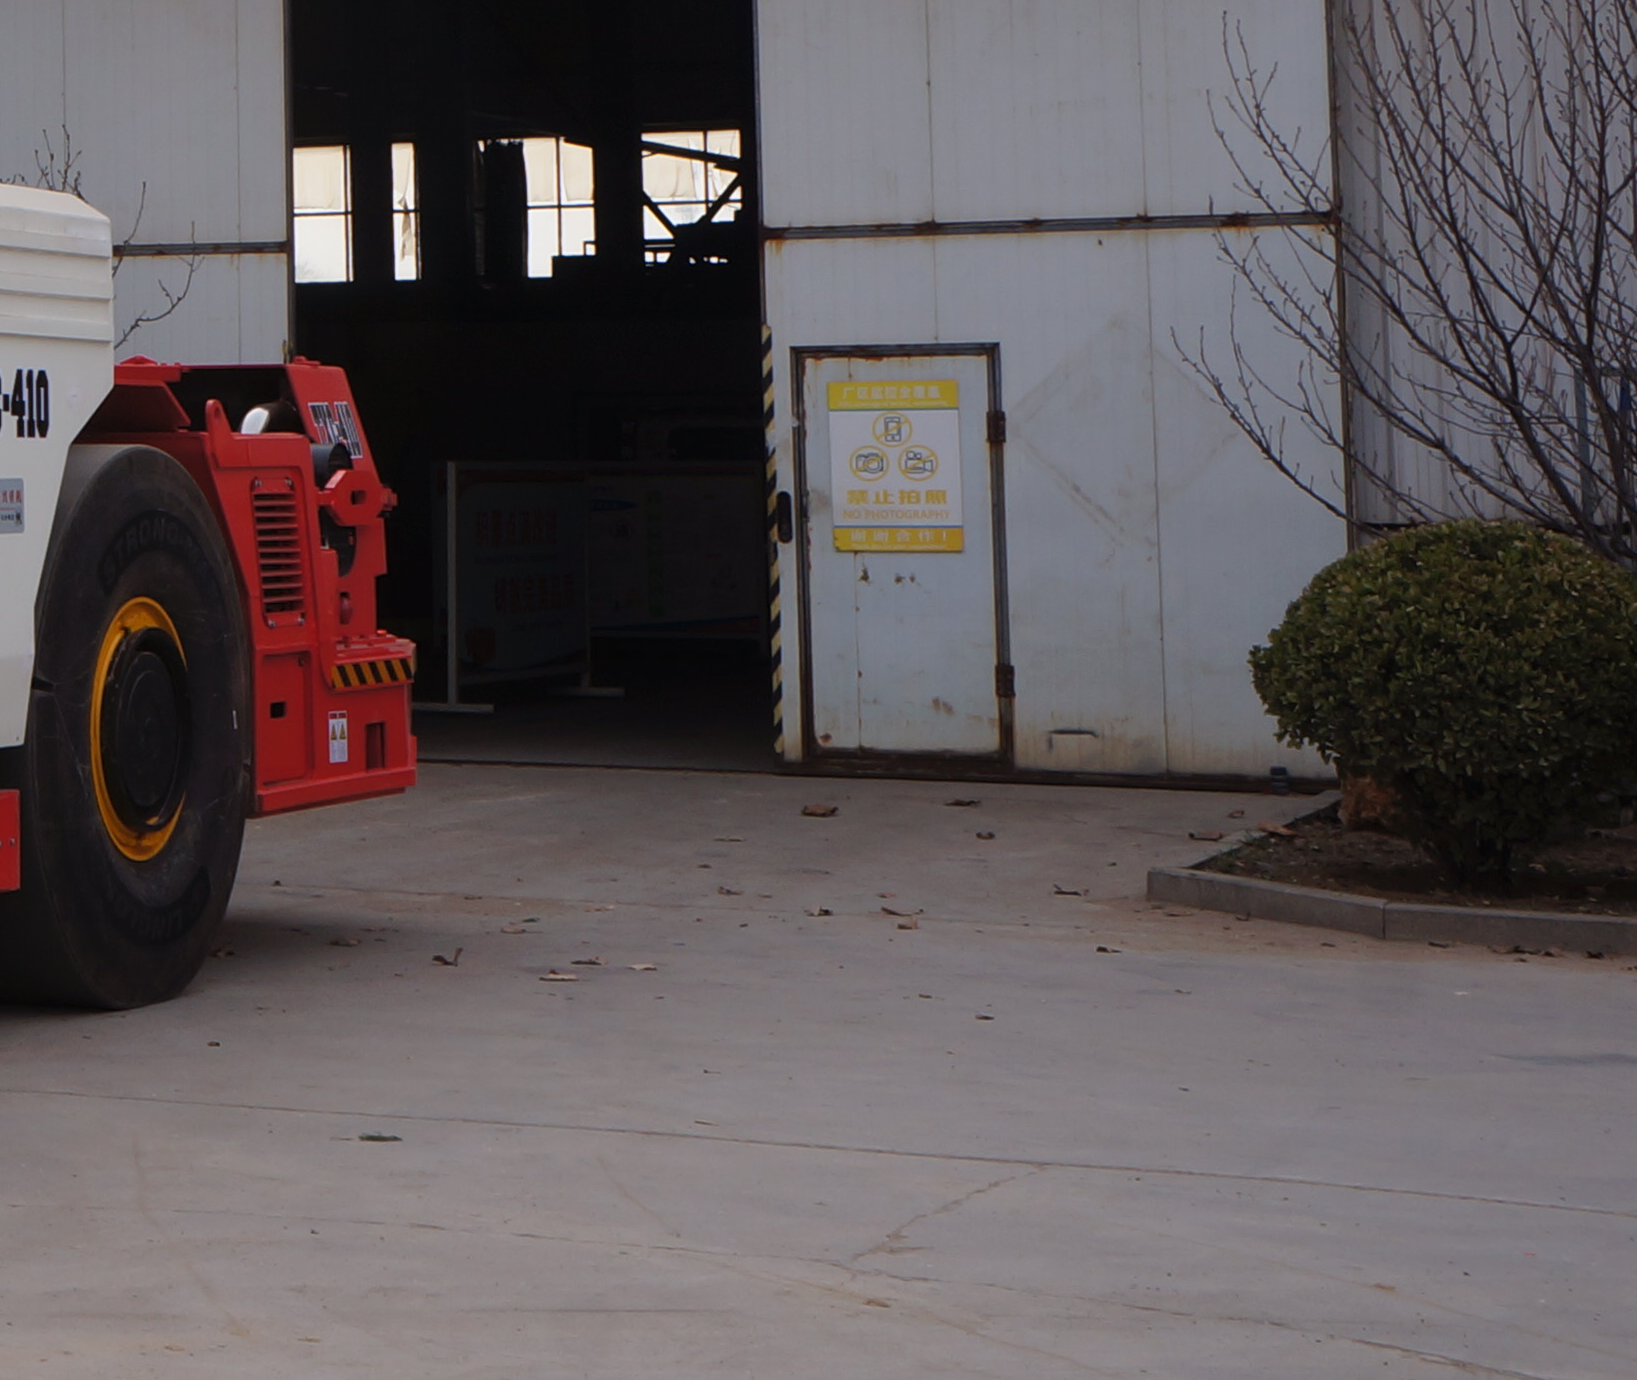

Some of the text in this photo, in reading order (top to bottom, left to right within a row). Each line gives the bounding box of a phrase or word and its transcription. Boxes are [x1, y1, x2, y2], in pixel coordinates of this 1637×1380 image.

[847, 490, 947, 505] 禁止拍照
[842, 509, 950, 520] NO PHOTOGRAPHY
